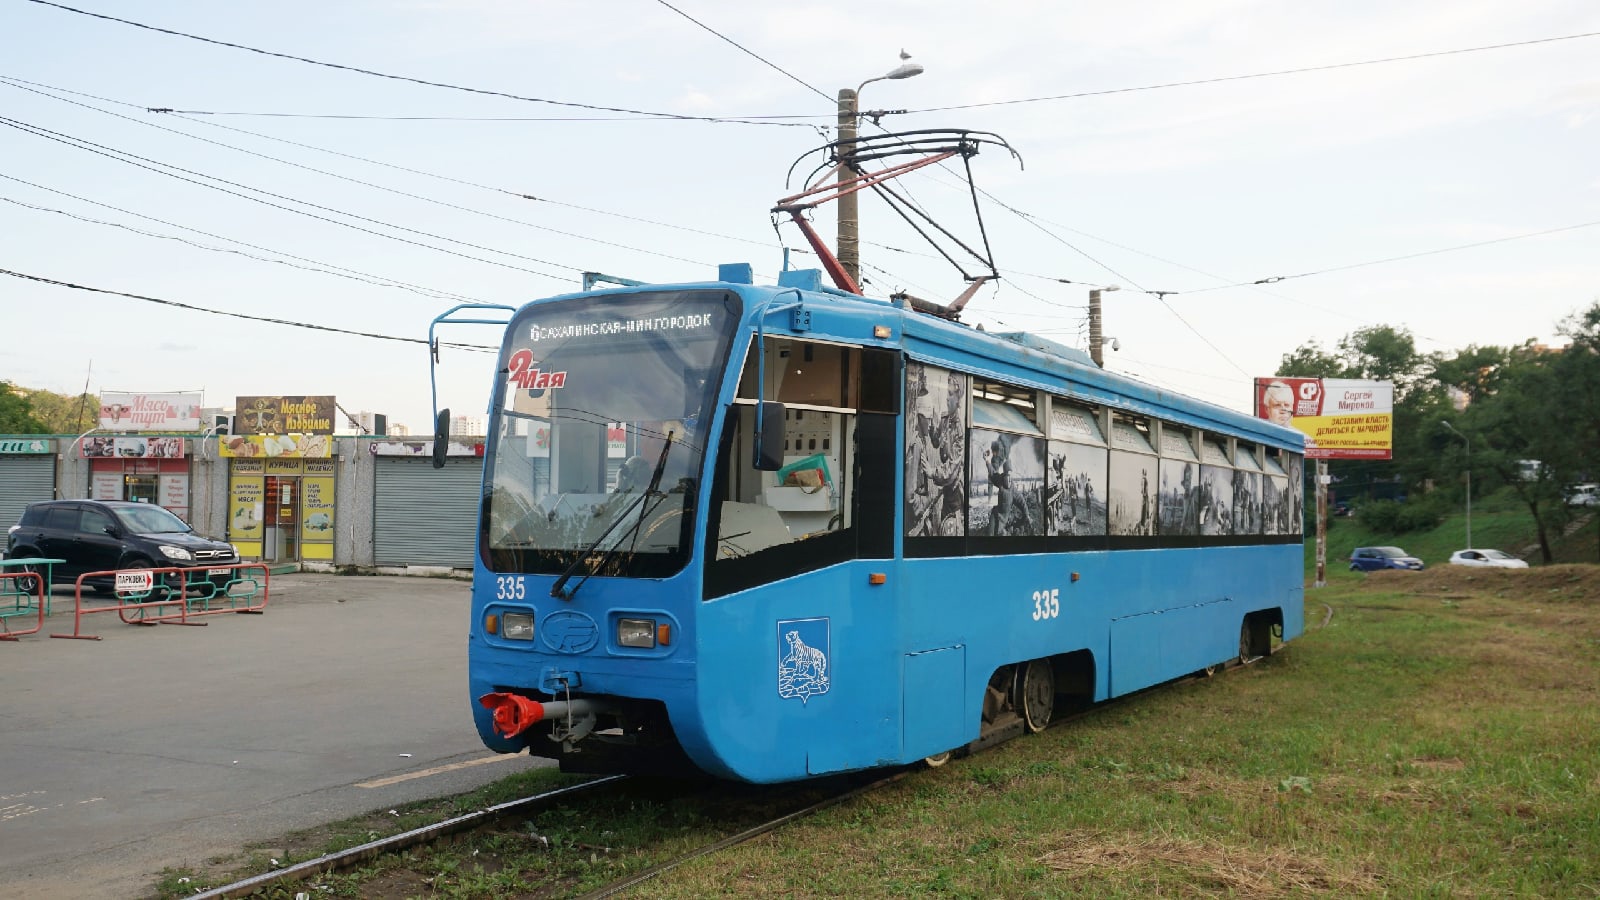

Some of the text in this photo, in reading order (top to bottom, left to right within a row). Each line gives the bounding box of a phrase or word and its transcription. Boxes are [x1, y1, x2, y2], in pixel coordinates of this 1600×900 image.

[508, 349, 567, 389] 9 Мая
[1344, 390, 1373, 400] Сергей
[132, 395, 168, 411] Мясо
[281, 398, 317, 413] Мясное
[1338, 400, 1374, 410] Миронов
[130, 412, 166, 428] тут
[286, 415, 330, 430] Изобилие
[1332, 415, 1390, 425] ЗАСТАВИМ ВЛАСТЬ
[1316, 426, 1350, 436] ДЕЛИТЬСЯ
[269, 461, 299, 469] КУРИЦА
[118, 574, 146, 585] ПАРКОВКА
[496, 576, 525, 600] 335
[1032, 588, 1059, 621] 335
